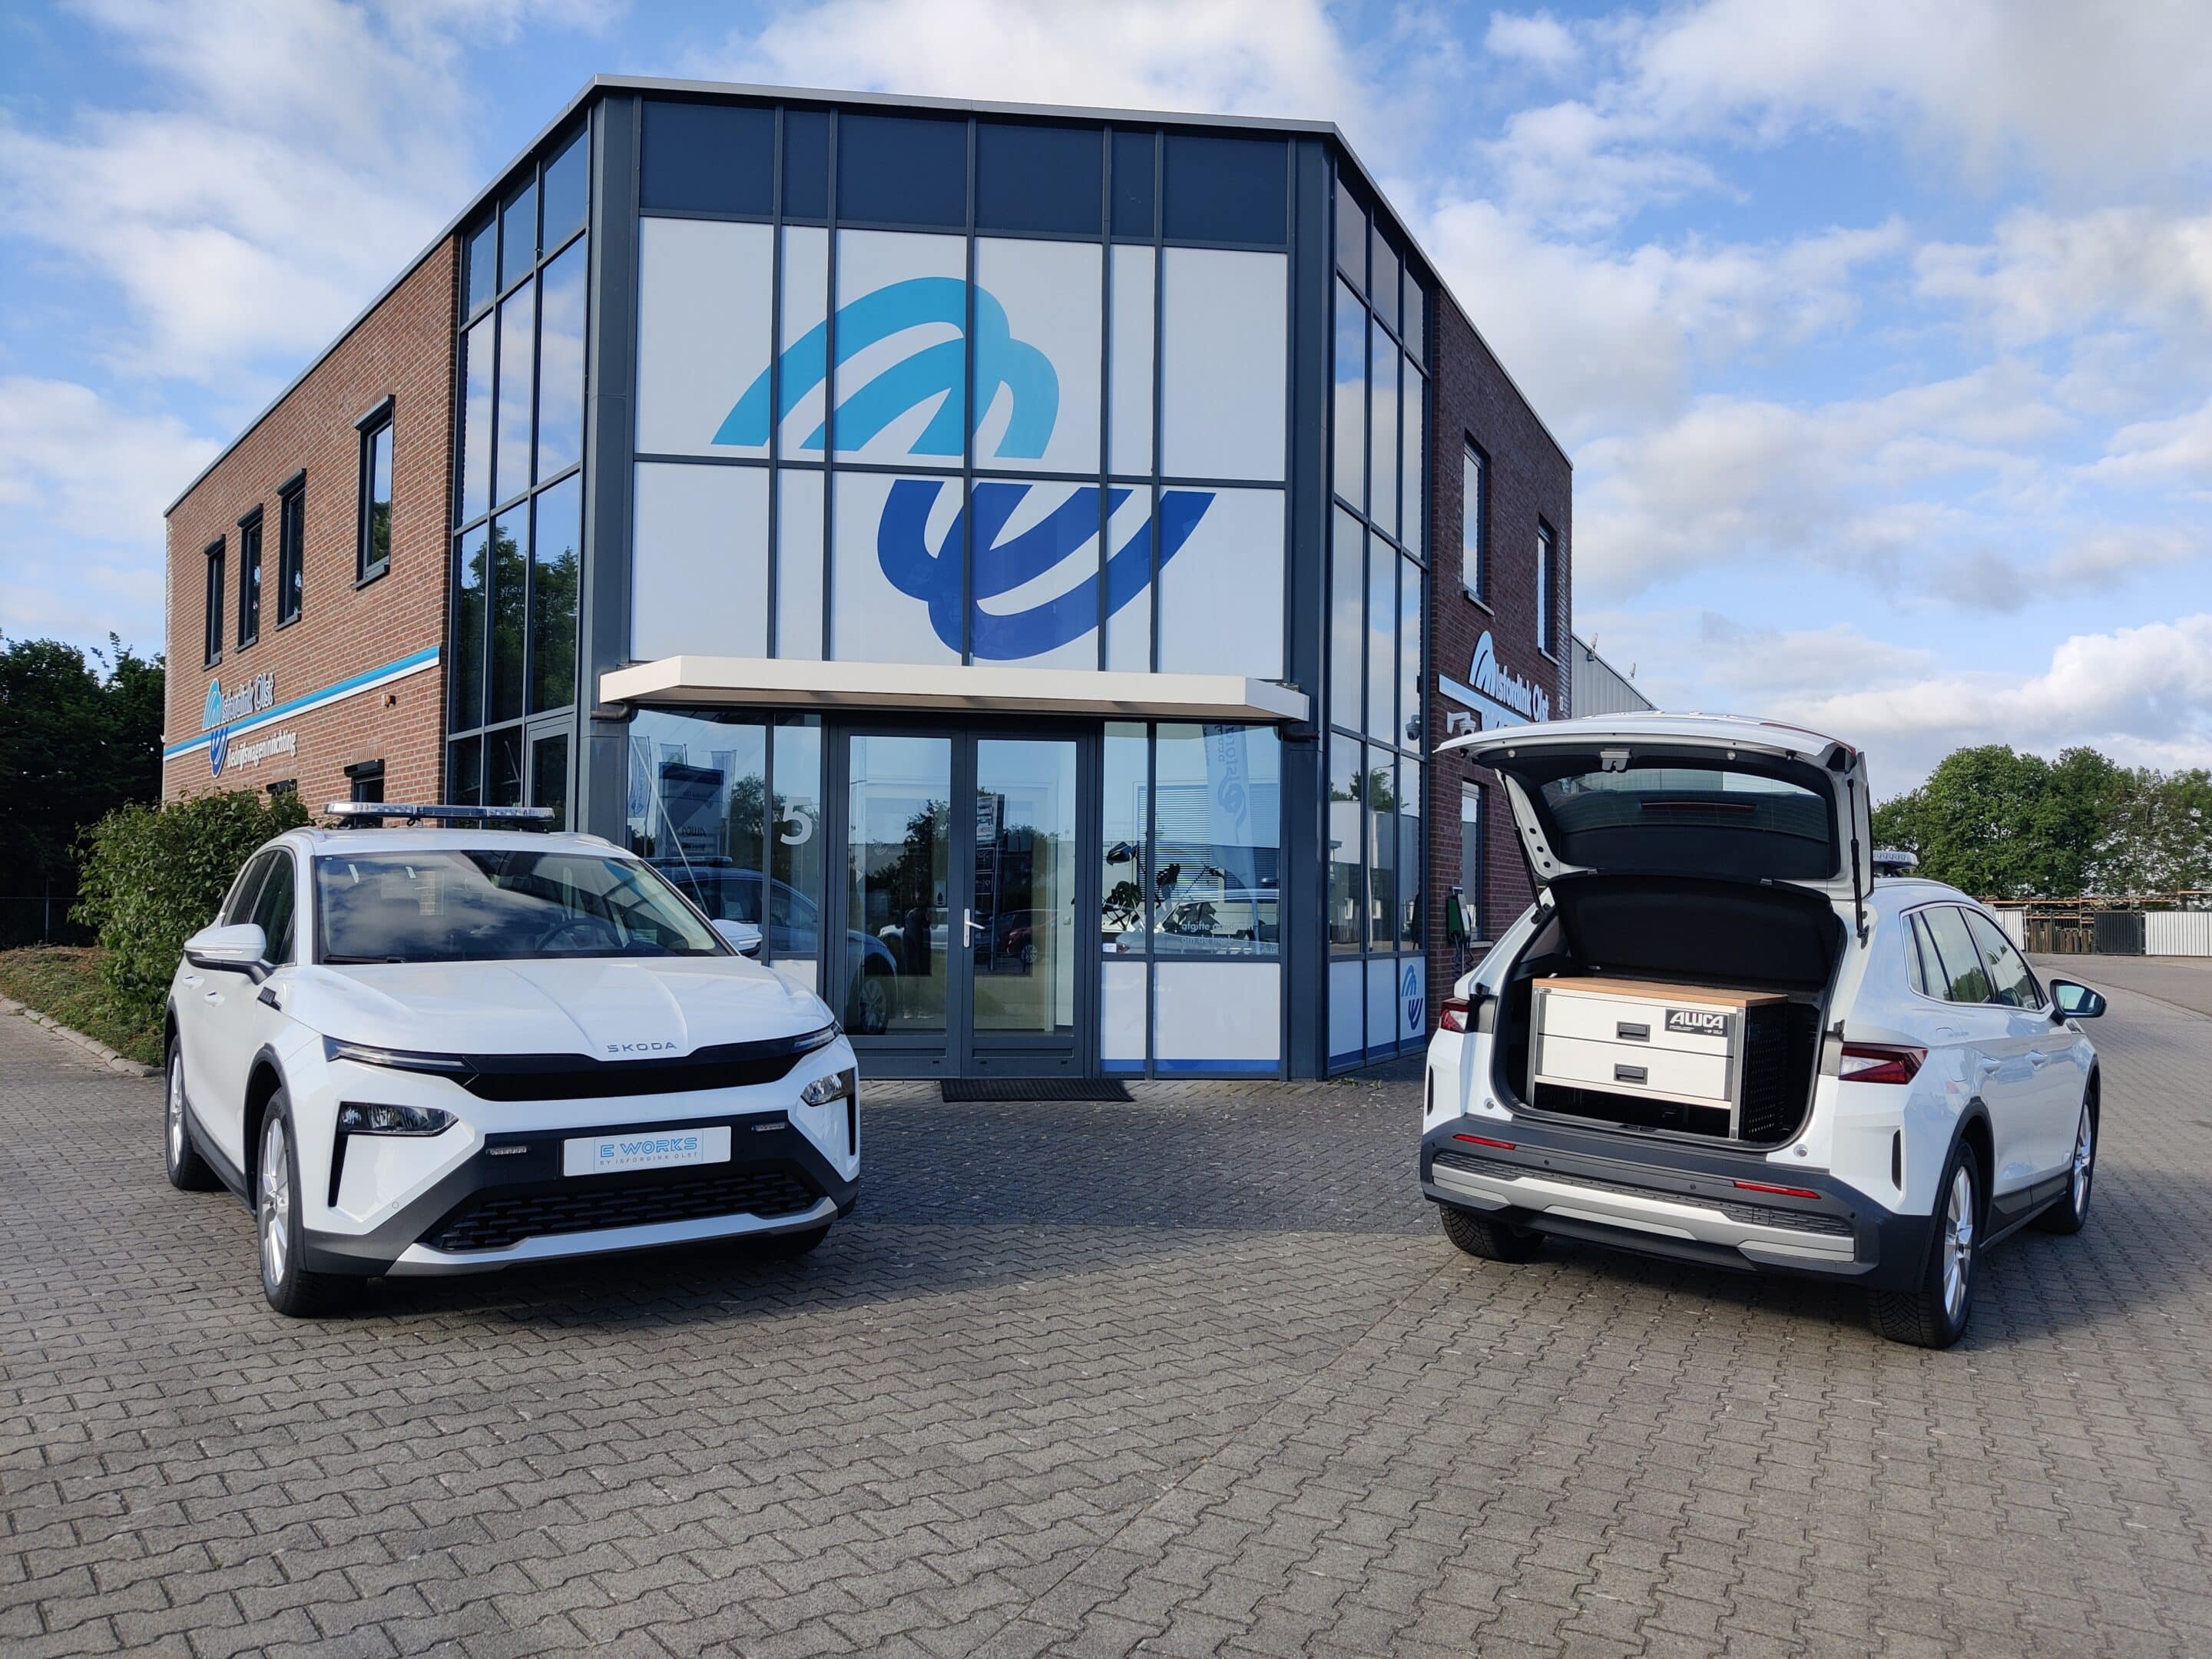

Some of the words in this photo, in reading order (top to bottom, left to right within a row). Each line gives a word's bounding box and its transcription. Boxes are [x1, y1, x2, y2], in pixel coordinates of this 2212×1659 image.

[254, 673, 275, 710] Olst
[780, 796, 813, 845] 5
[1670, 1012, 1724, 1029] ALUCA
[600, 1144, 614, 1157] E
[620, 1137, 698, 1155] WORKS
[616, 1154, 669, 1164] ISFORDINK
